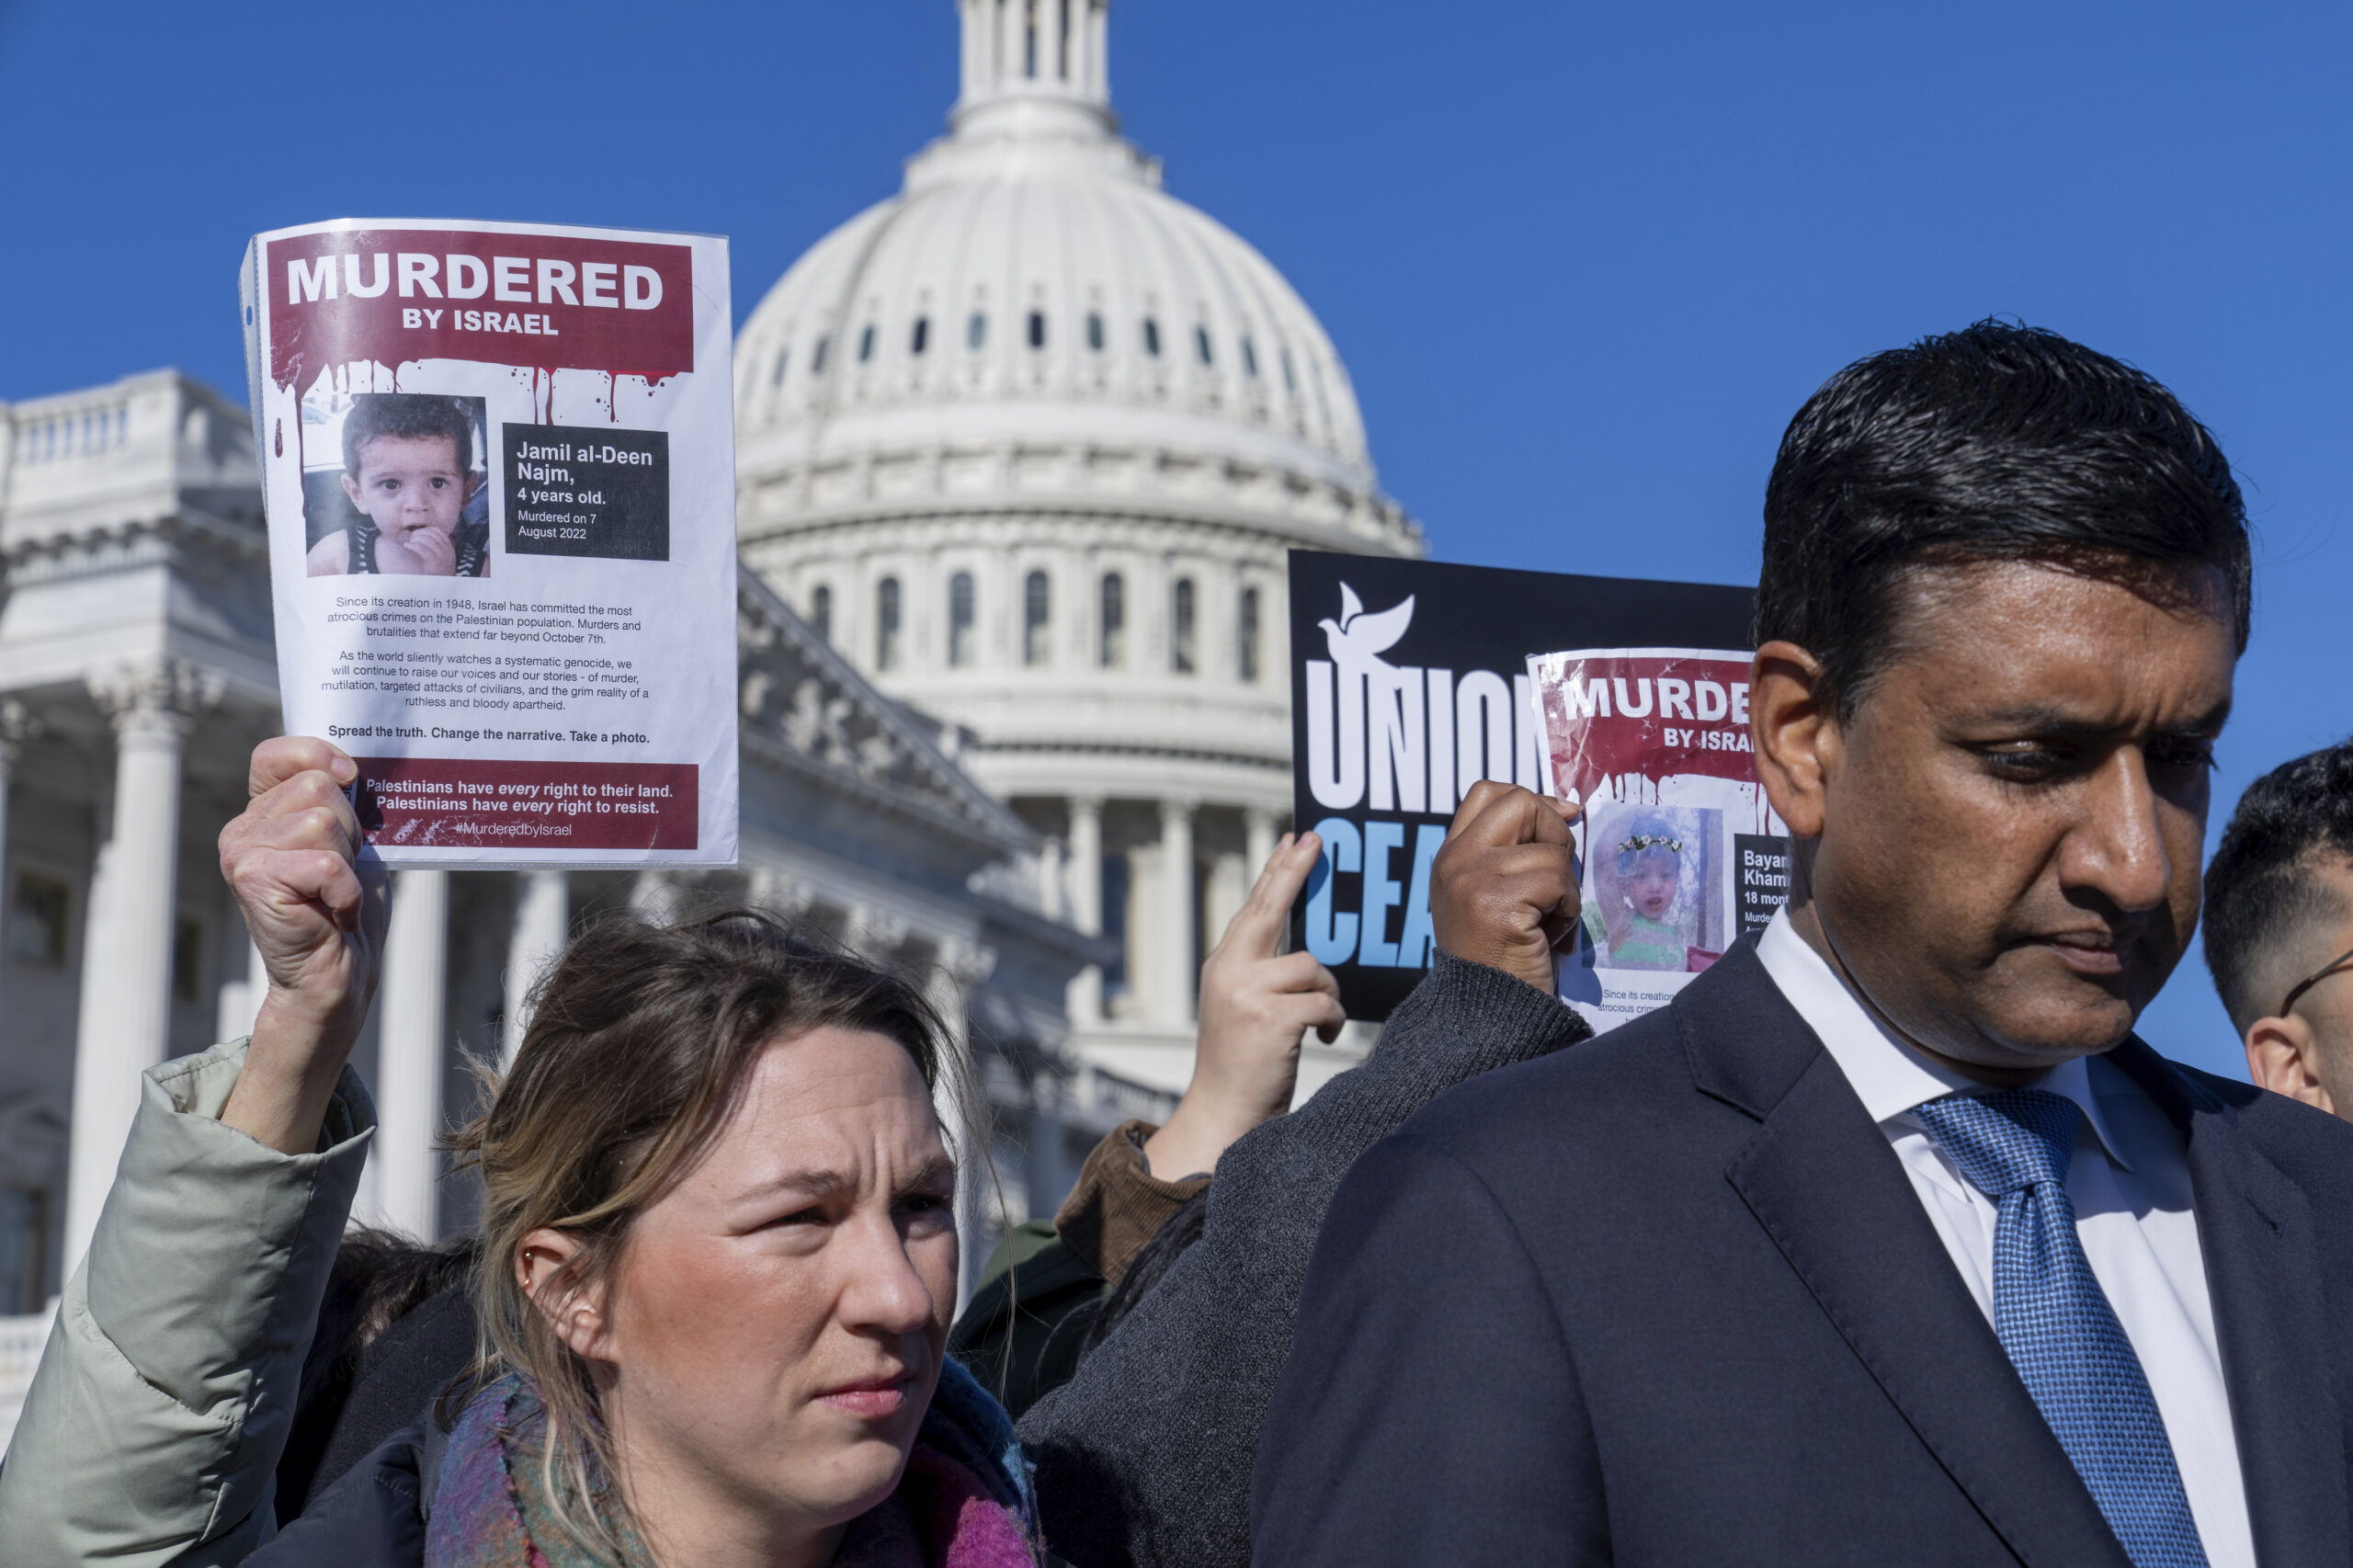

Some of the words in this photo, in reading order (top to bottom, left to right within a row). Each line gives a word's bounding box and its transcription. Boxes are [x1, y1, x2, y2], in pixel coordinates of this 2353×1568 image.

[289, 254, 662, 310] MURDERED
[403, 309, 443, 329] BY
[454, 311, 559, 335] ISRAEL
[517, 441, 570, 460] Jamil
[577, 446, 652, 465] al-Deen
[518, 462, 574, 485] Najm,
[517, 487, 527, 500] 4
[531, 491, 573, 504] years
[578, 491, 605, 504] old.
[518, 510, 570, 522] Murdered
[590, 515, 596, 524] 7
[518, 526, 556, 539] August
[560, 528, 586, 539] 2022
[336, 597, 368, 607] Since
[372, 597, 384, 606] its
[388, 598, 429, 608] creation
[434, 599, 441, 608] in
[447, 599, 474, 610] 1948,
[479, 601, 506, 610] Israel
[510, 601, 528, 611] has
[531, 605, 585, 614] committed
[588, 605, 604, 614] the
[608, 608, 631, 616] most
[328, 611, 379, 621] atrocious
[381, 612, 416, 622] crimes
[437, 614, 452, 623] the
[457, 614, 513, 625] Palestinian
[517, 618, 574, 629] population.
[578, 619, 619, 630] Murders
[622, 621, 641, 631] and
[367, 626, 416, 637] brutalities
[420, 629, 439, 638] that
[443, 630, 480, 639] extend
[483, 630, 497, 640] far
[501, 631, 539, 642] beyond
[543, 632, 585, 642] October
[588, 634, 606, 643] 7th.
[340, 651, 354, 660] As
[358, 651, 374, 660] the
[377, 653, 404, 662] world
[407, 653, 443, 665] sliently
[447, 654, 492, 664] watches
[506, 656, 561, 667] systematic
[564, 658, 613, 669] genocide,
[332, 665, 349, 675] will
[354, 665, 396, 676] continue
[399, 667, 409, 676] to
[500, 670, 518, 679] and
[543, 672, 577, 681] stories
[588, 673, 598, 682] of
[601, 674, 638, 684] murder,
[322, 680, 377, 691] mutilation,
[381, 681, 420, 693] targeted
[424, 683, 462, 692] attacks
[466, 684, 477, 693] of
[480, 684, 524, 695] civilians,
[529, 686, 548, 695] and
[551, 686, 568, 695] the
[571, 687, 593, 698] grim
[597, 687, 627, 699] reality
[631, 688, 640, 698] of
[406, 697, 446, 707] ruthless
[449, 699, 469, 707] and
[473, 699, 509, 710] bloody
[513, 700, 564, 710] apartheid.
[329, 725, 371, 738] Spread
[375, 726, 392, 736] the
[396, 727, 426, 737] truth.
[432, 727, 479, 741] Change
[483, 729, 503, 739] the
[507, 730, 565, 741] narrative.
[570, 731, 597, 742] Take
[612, 732, 649, 744] photo.
[1664, 728, 1694, 747] BY
[367, 778, 453, 795] Palestinians
[459, 781, 494, 794] have
[499, 785, 540, 798] every
[544, 783, 578, 799] right
[583, 784, 597, 796] to
[601, 784, 634, 796] their
[639, 785, 672, 797] land.
[377, 796, 468, 811] Palestinians
[473, 798, 507, 811] have
[513, 801, 553, 814] every
[558, 800, 592, 815] right
[596, 801, 610, 812] to
[616, 801, 658, 813] resist.
[455, 822, 572, 837] #MurderedbyIsrael
[1744, 869, 1790, 887] Kham
[1745, 892, 1757, 903] 18
[1603, 989, 1626, 999] Since
[1629, 990, 1638, 1000] its
[1597, 1004, 1634, 1013] atrocious
